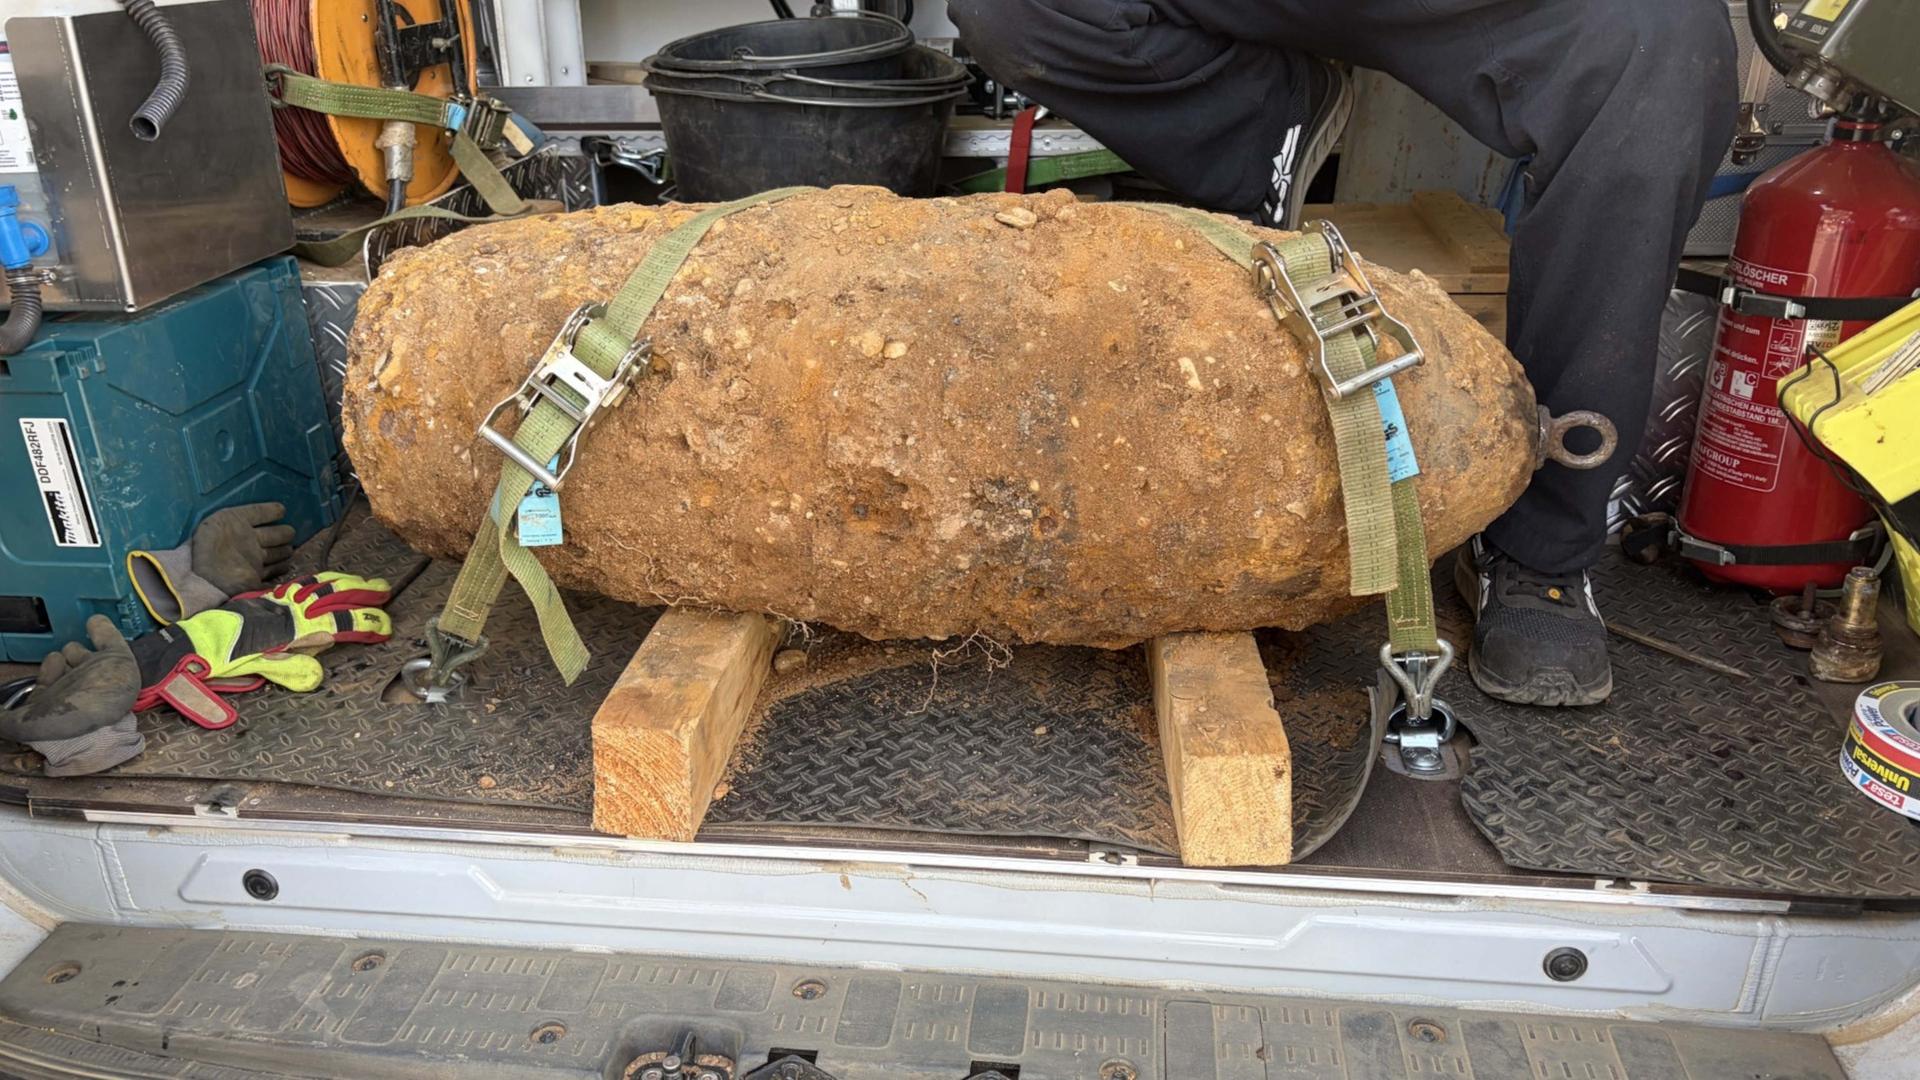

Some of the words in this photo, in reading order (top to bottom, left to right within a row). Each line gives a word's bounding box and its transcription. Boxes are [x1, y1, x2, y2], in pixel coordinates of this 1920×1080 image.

[1731, 261, 1788, 286] ERLÖSCHER
[1745, 325, 1760, 335] zum
[1746, 373, 1757, 386] C
[23, 421, 51, 484] DDF482RFJ
[1853, 746, 1911, 792] Universal
[1870, 783, 1902, 806] tesa
